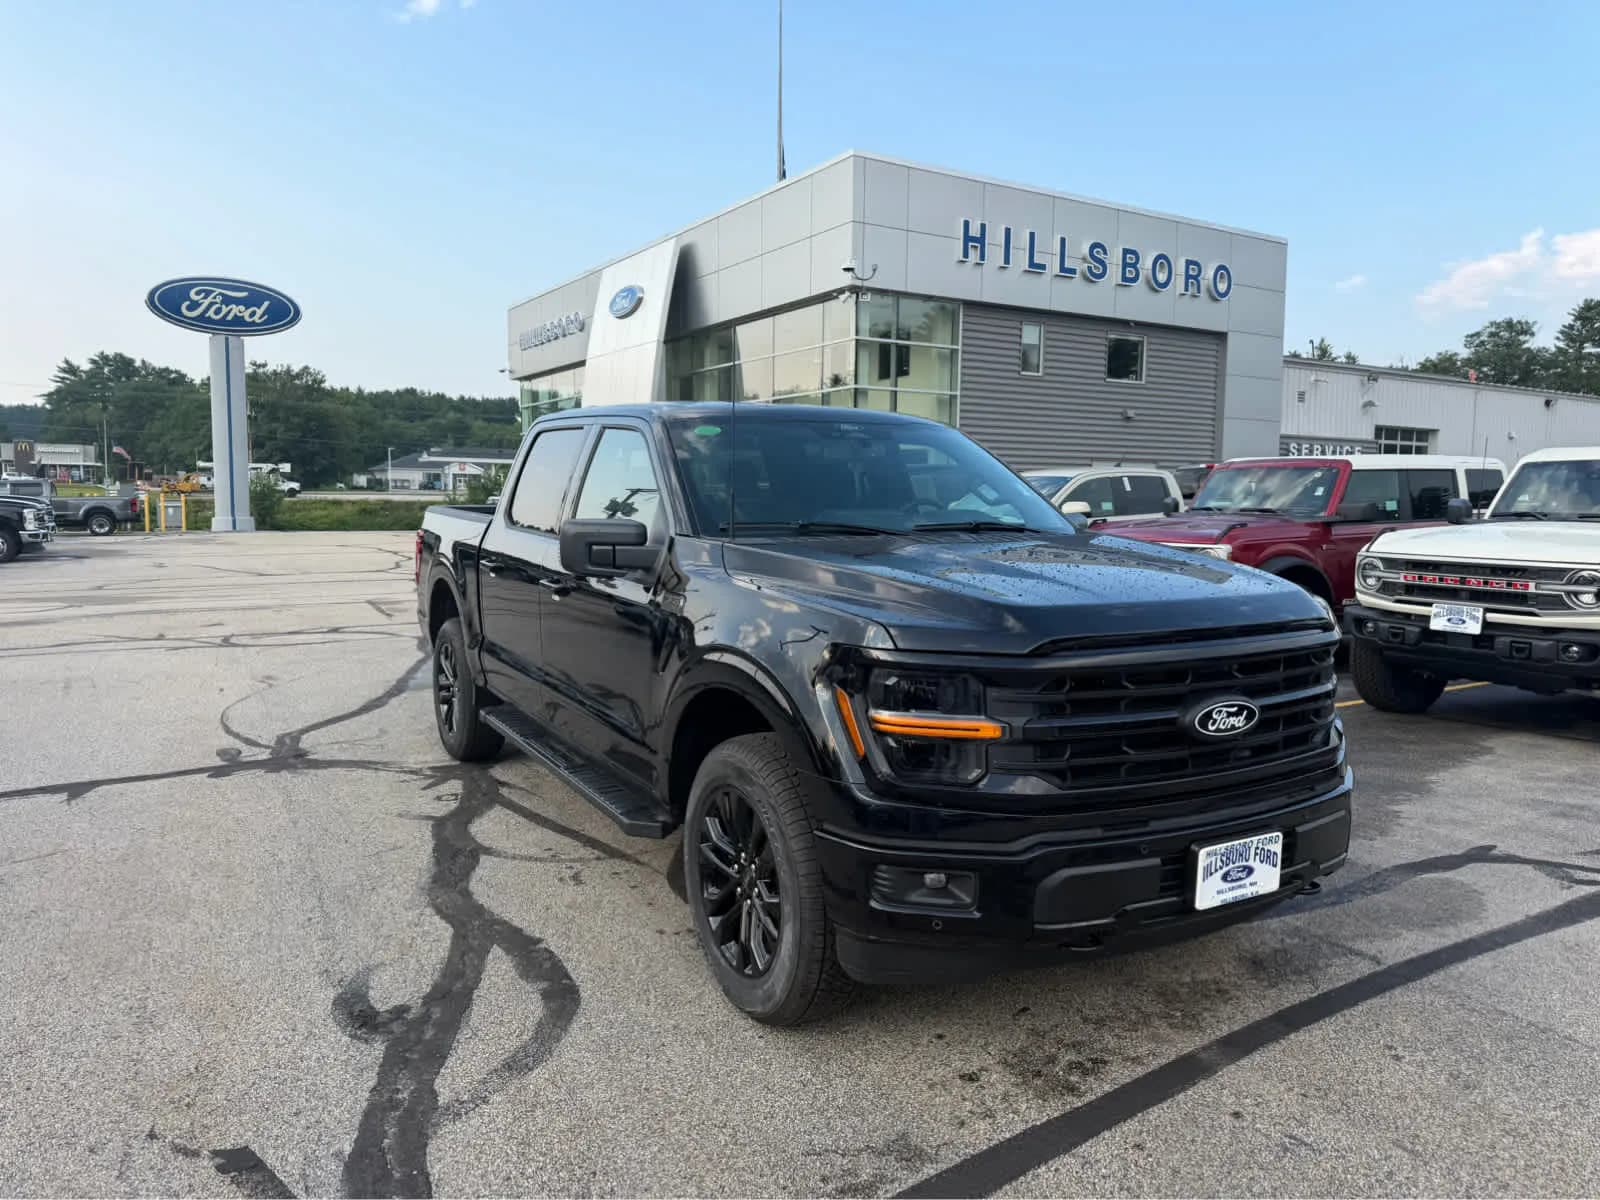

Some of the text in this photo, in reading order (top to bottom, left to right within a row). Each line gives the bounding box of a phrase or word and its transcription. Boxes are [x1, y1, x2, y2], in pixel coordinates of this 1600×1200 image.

[960, 218, 1233, 300] HILLSBORO
[180, 286, 271, 323] Ford
[1288, 442, 1363, 456] SERVICE
[1207, 706, 1248, 731] Ford
[1253, 846, 1279, 868] FORD
